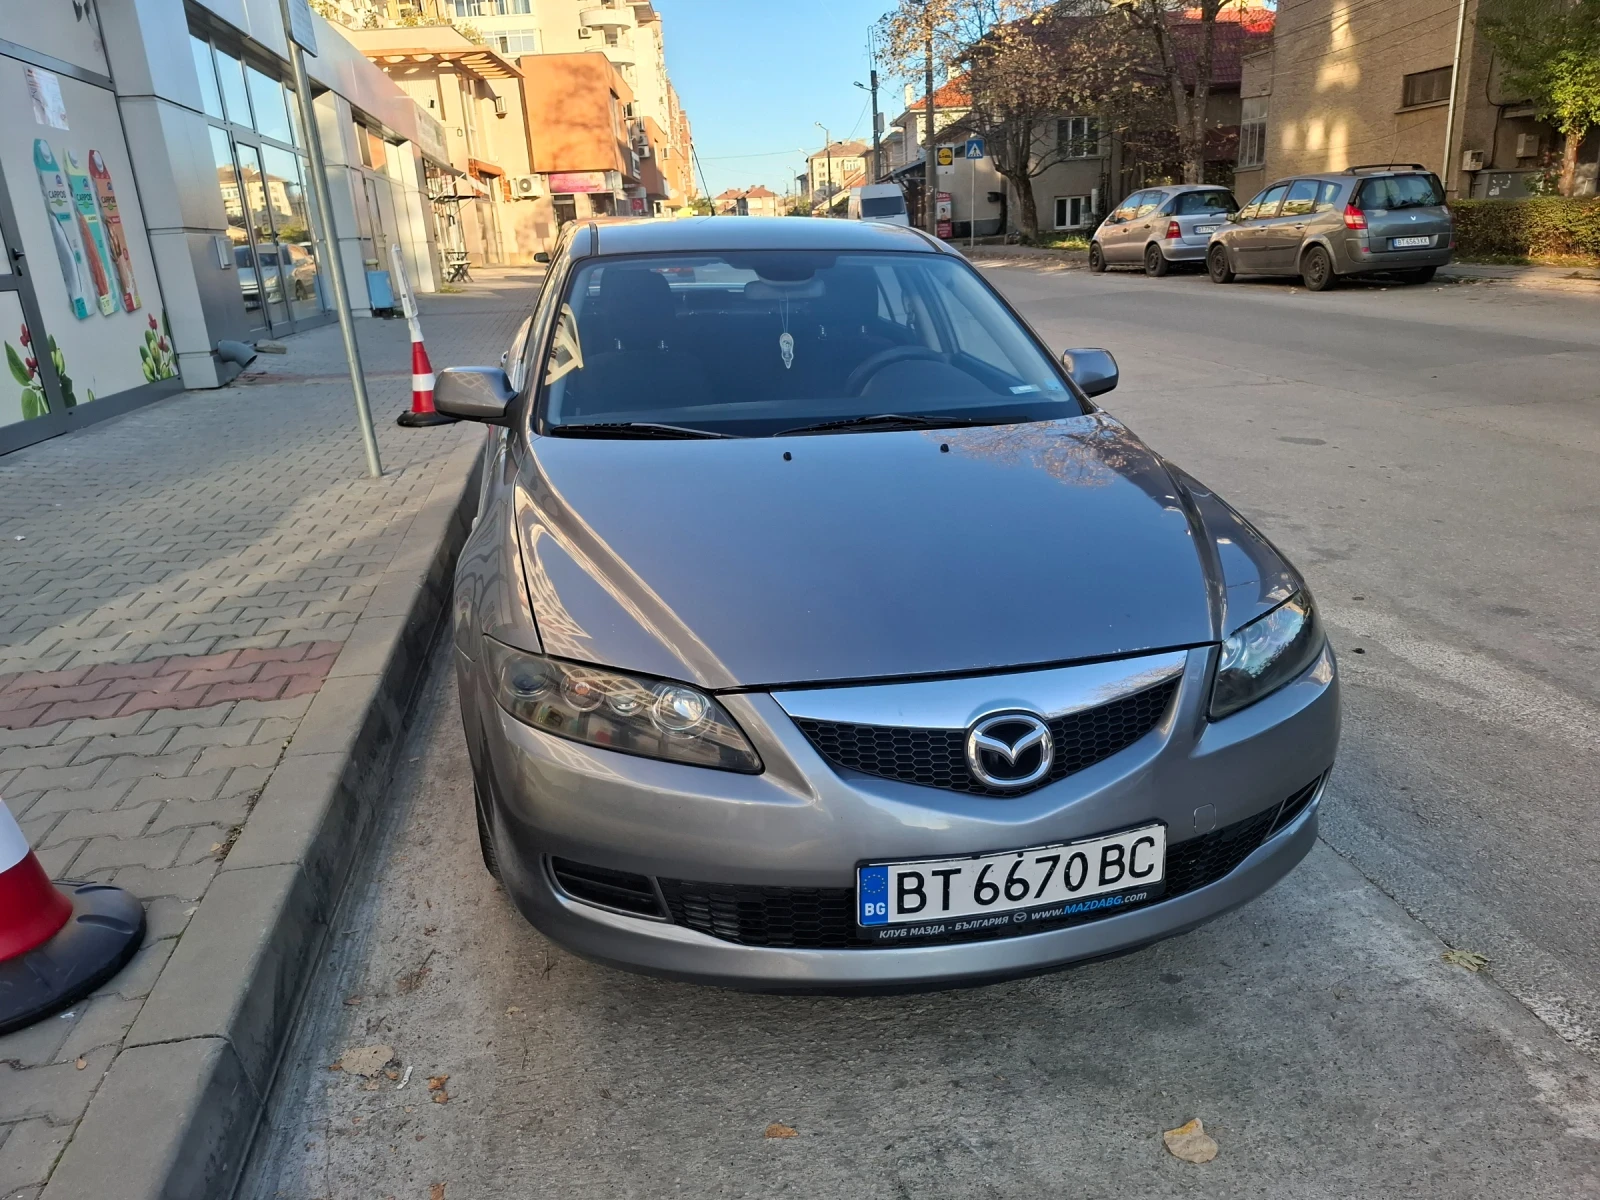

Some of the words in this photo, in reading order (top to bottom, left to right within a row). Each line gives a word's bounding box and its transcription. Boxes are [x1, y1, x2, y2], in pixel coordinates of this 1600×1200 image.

[48, 190, 67, 199] CARPOS
[76, 193, 93, 202] CARPOS
[101, 195, 117, 204] CARPOS
[896, 870, 962, 915] BT
[973, 851, 1089, 906] 6670
[1098, 835, 1156, 887] BC
[864, 902, 886, 916] BG
[1031, 891, 1147, 920] www.MAZDABG.com
[879, 928, 907, 939] КЛУБ
[910, 924, 945, 937] МАЗДА
[954, 916, 1009, 932] БЪЛГАРИЯ
